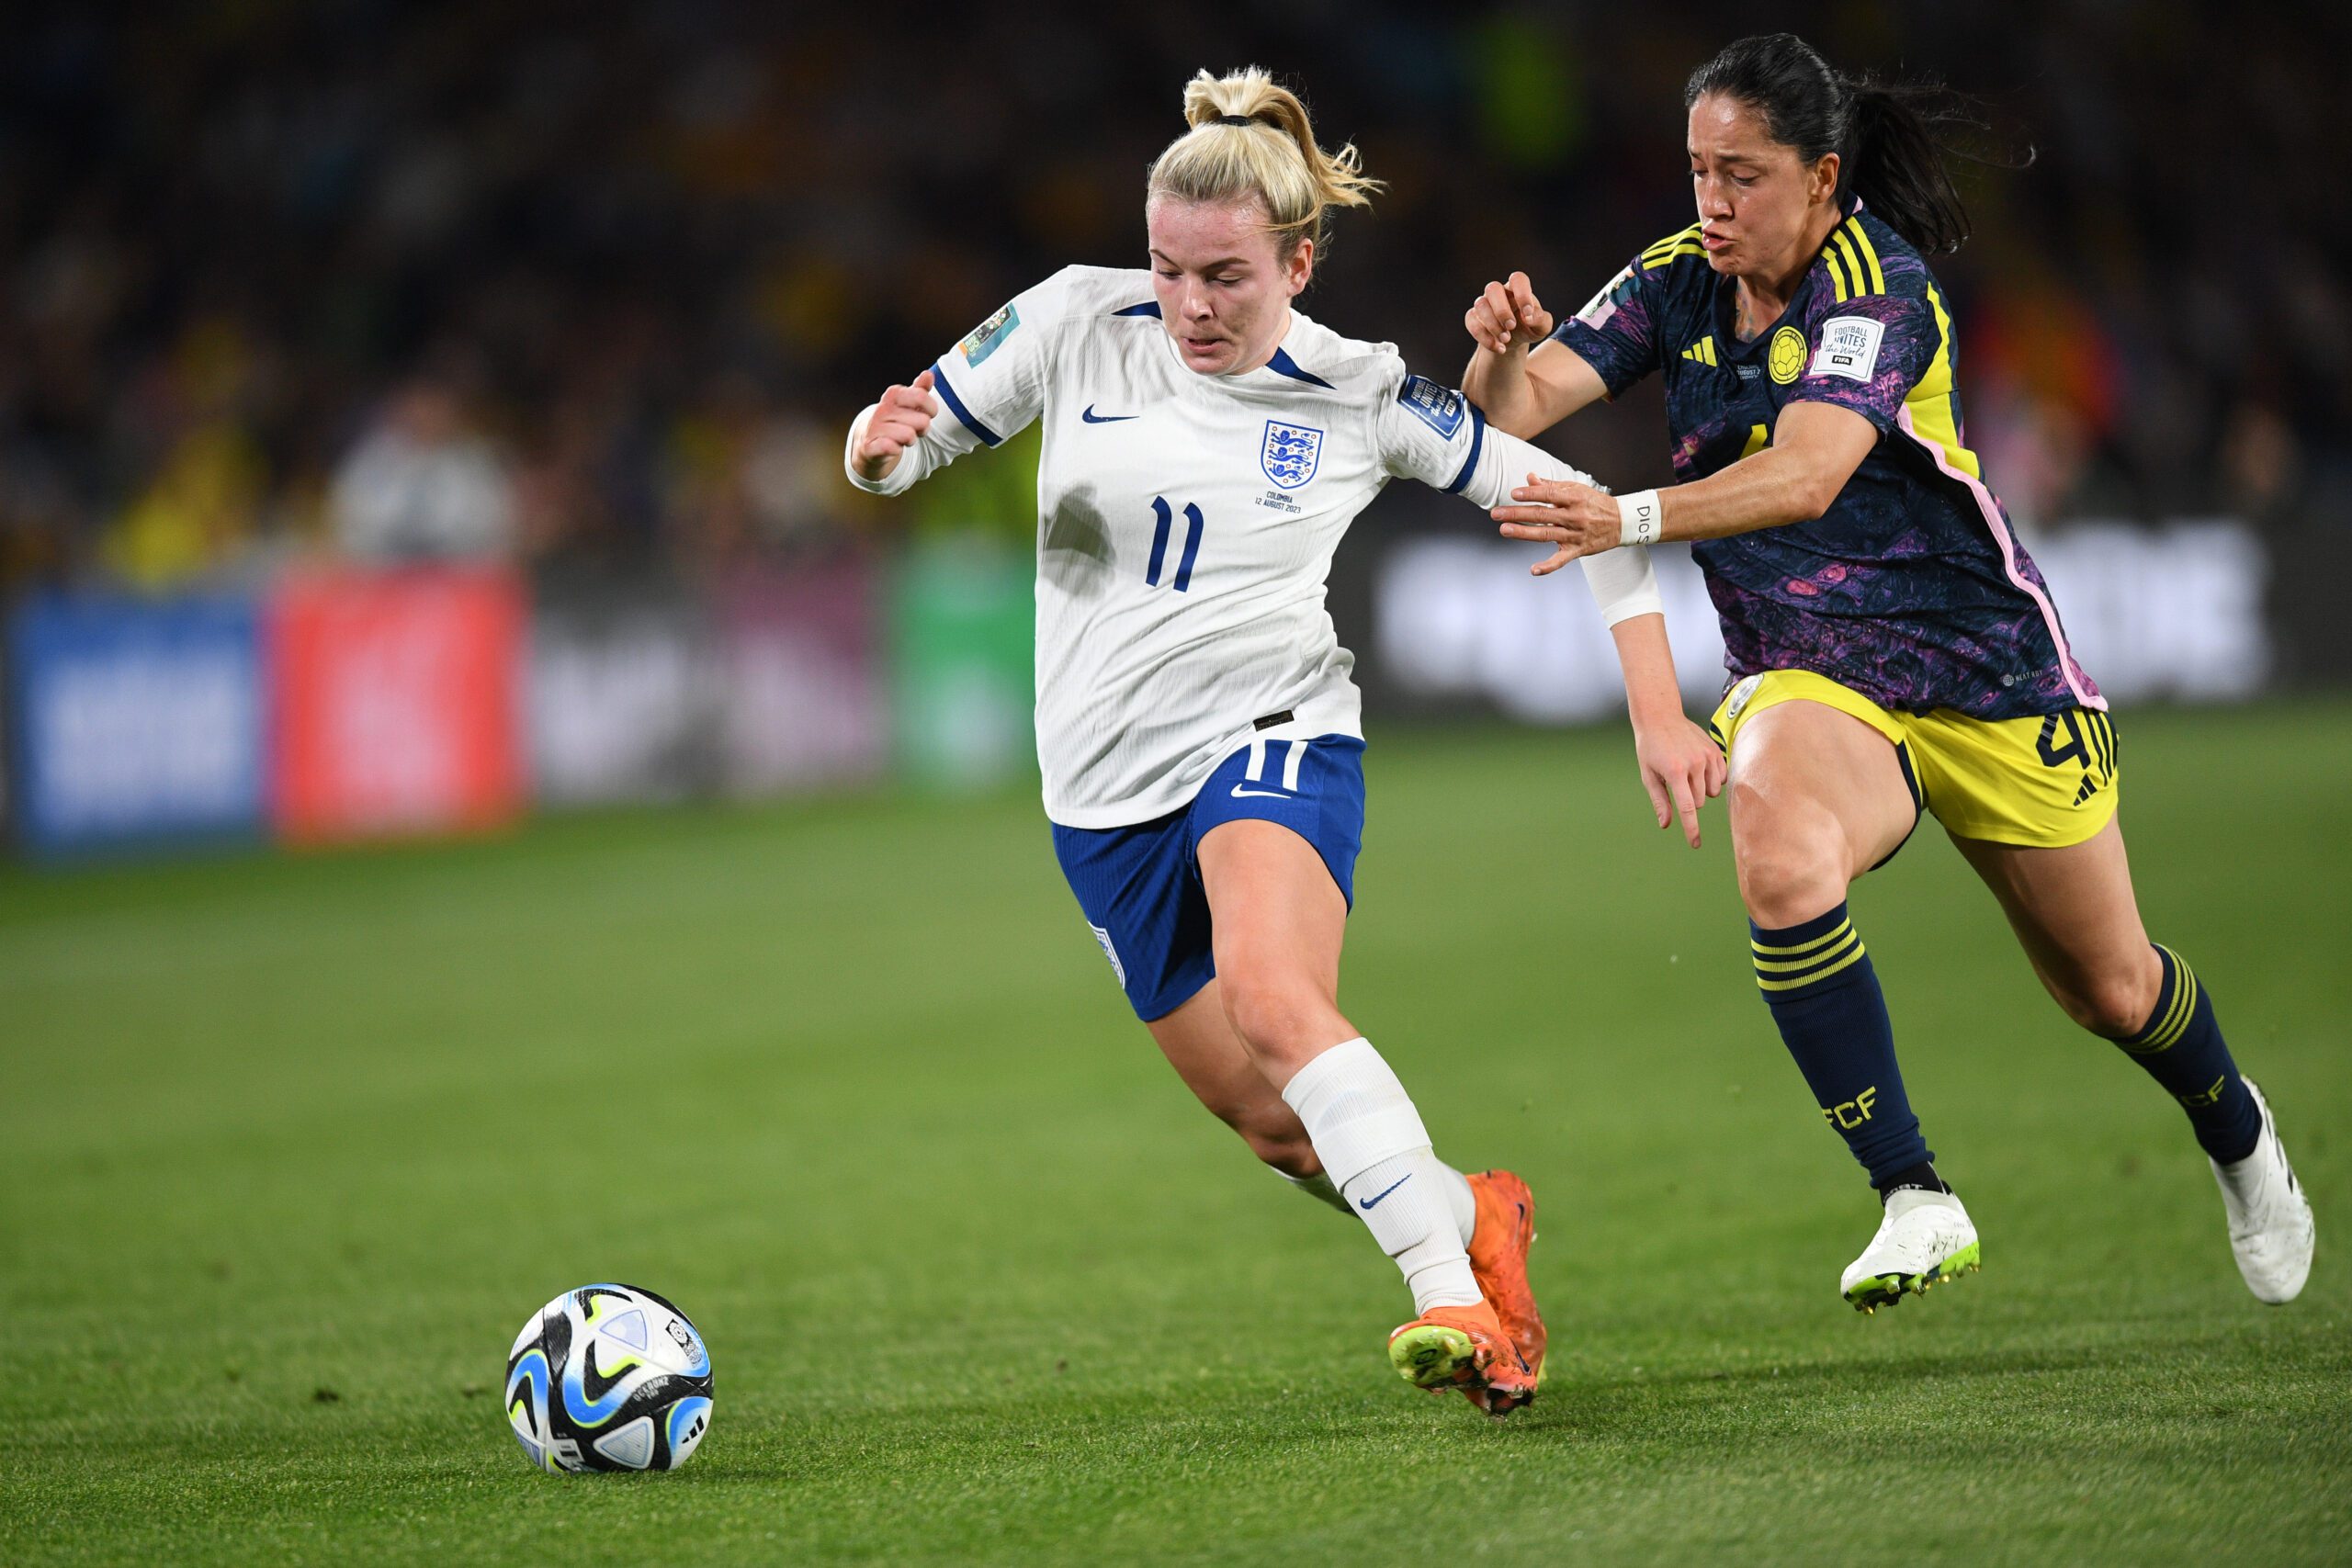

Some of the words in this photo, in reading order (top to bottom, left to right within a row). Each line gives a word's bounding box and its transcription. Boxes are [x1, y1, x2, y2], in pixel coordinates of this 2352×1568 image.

[1835, 325, 1868, 338] FOOTBALL
[1834, 356, 1851, 365] FIFA
[1839, 346, 1866, 359] World
[1419, 383, 1438, 409] UNITES
[1255, 497, 1262, 505] 12
[1263, 499, 1285, 510] AUGUST
[1285, 504, 1302, 514] 2023
[1266, 491, 1294, 503] COLOMBIA
[1637, 505, 1650, 545] DIOS
[1145, 495, 1204, 593] 11
[2035, 709, 2091, 770] 4
[1245, 737, 1308, 792] 11
